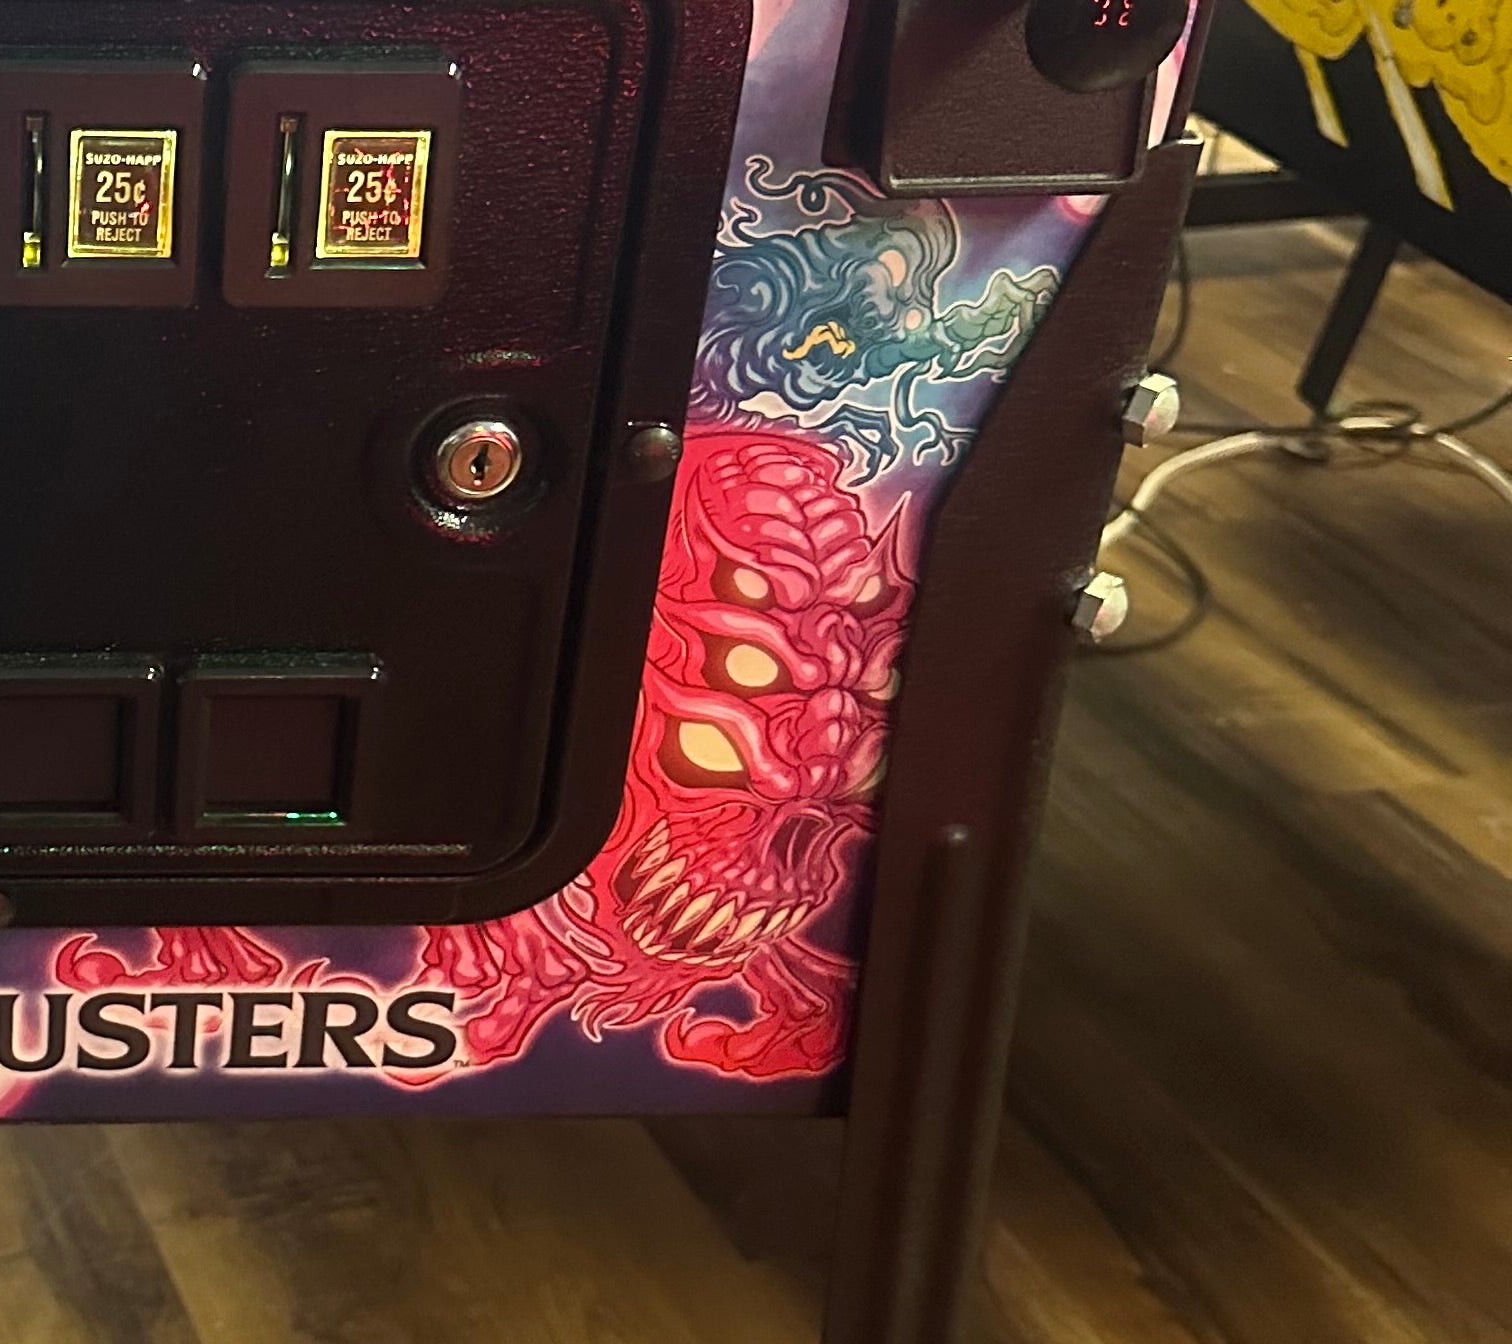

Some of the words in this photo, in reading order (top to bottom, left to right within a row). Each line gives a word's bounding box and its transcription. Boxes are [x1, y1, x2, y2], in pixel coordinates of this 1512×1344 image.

[95, 170, 147, 205] 25¢
[346, 170, 398, 205] 25¢
[91, 209, 127, 226] PUSH
[131, 210, 150, 226] TO
[342, 209, 378, 226] PUSH
[382, 210, 400, 226] TO
[95, 227, 143, 243] REJECT
[345, 227, 393, 242] REJECT
